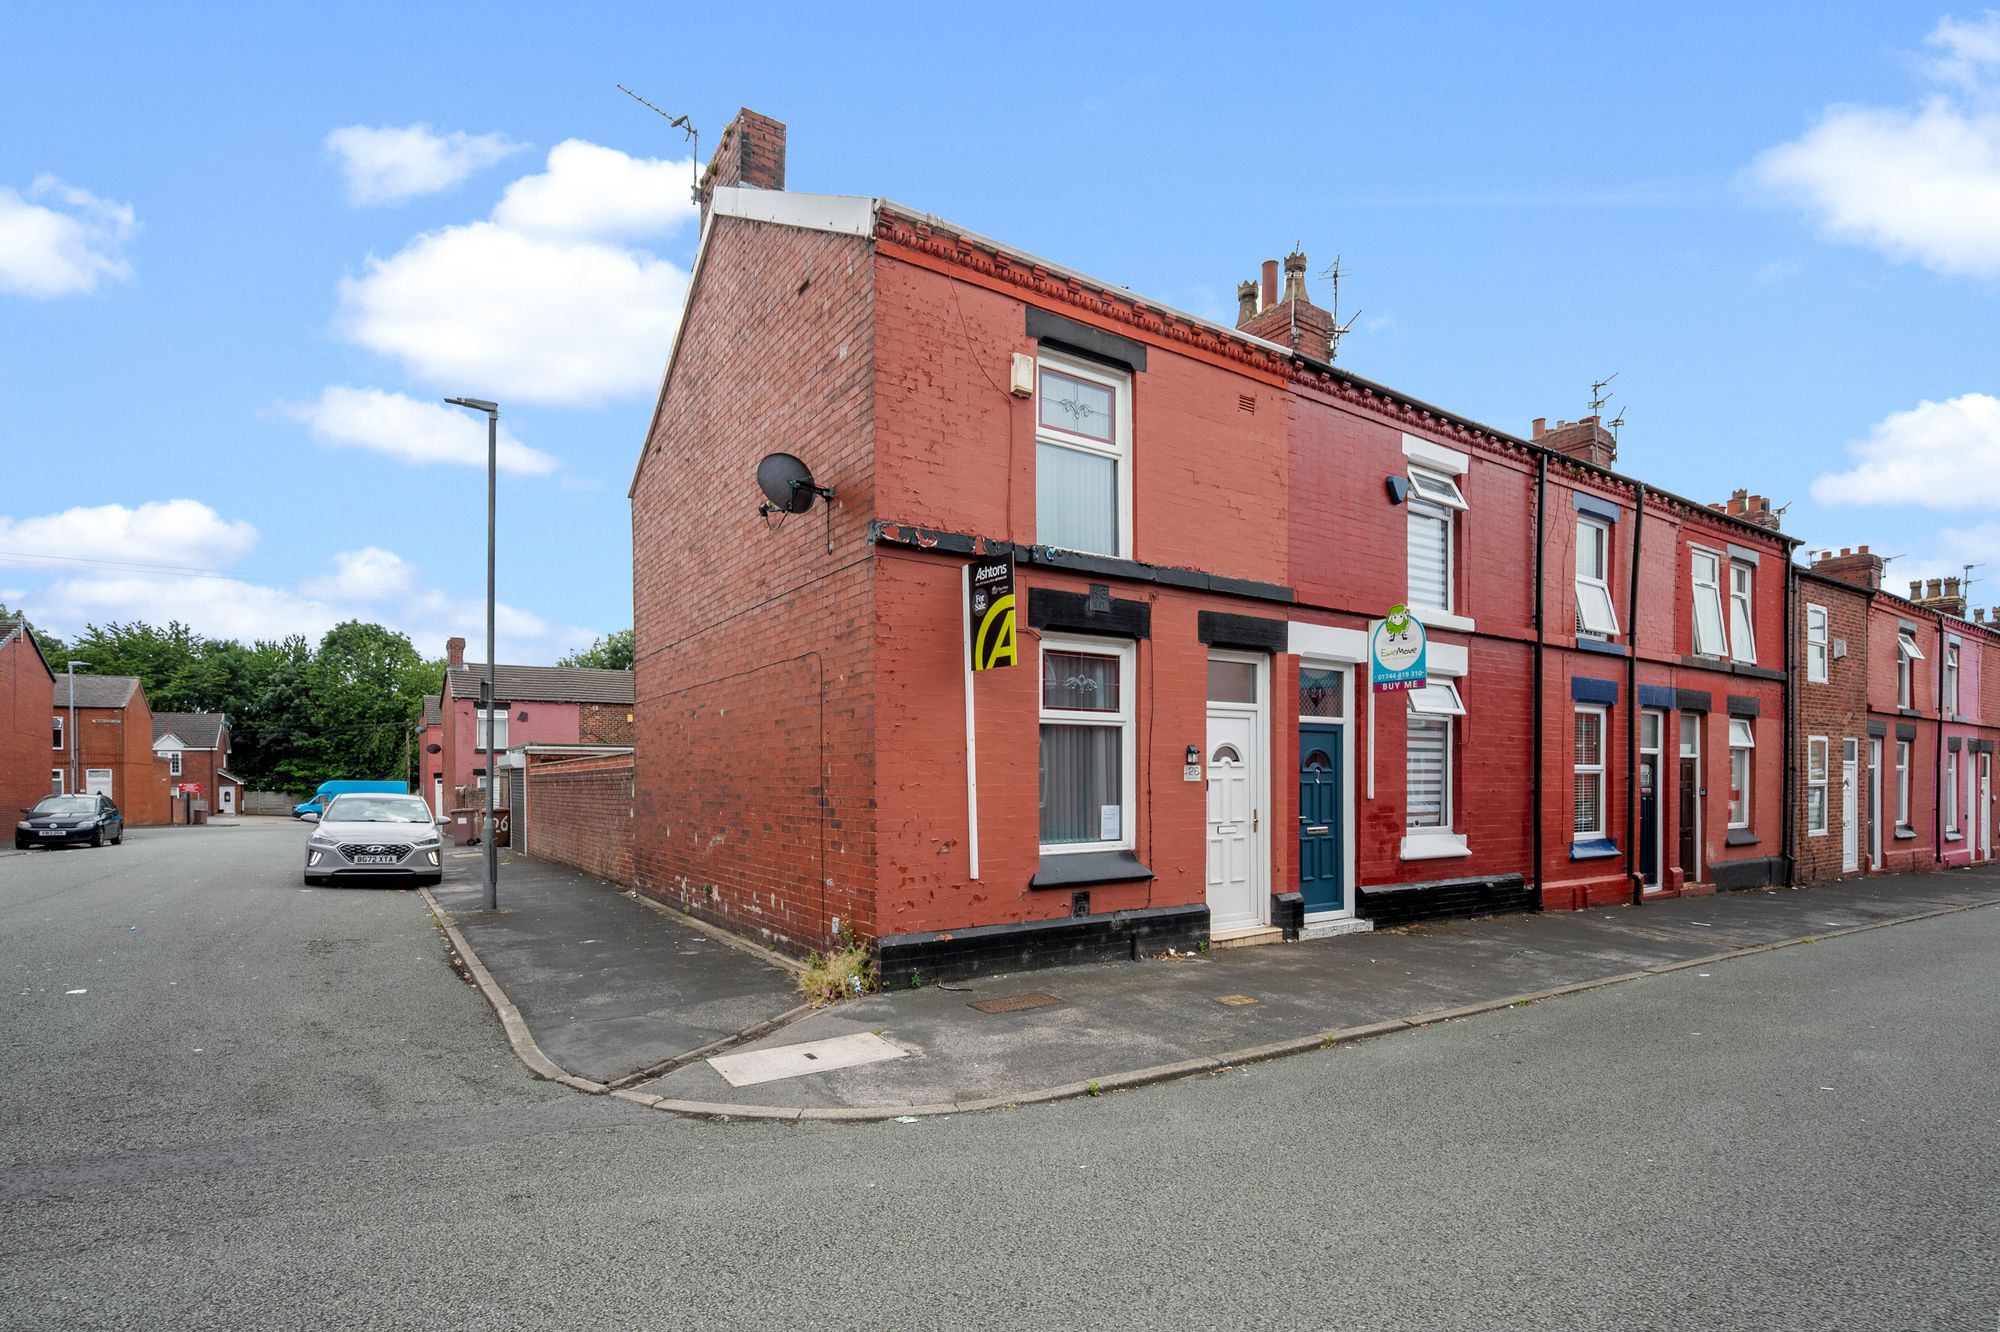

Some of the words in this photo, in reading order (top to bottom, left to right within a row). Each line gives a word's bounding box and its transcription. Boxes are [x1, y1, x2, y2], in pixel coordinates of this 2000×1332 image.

[975, 563, 1007, 581] Ashtons
[975, 594, 985, 602] For
[974, 601, 986, 611] Sale
[1380, 646, 1417, 658] EweMove
[1377, 672, 1396, 680] 01744
[1410, 670, 1423, 678] 310
[1382, 682, 1400, 690] BUY
[1404, 680, 1418, 688] ME
[1188, 766, 1200, 776] 26
